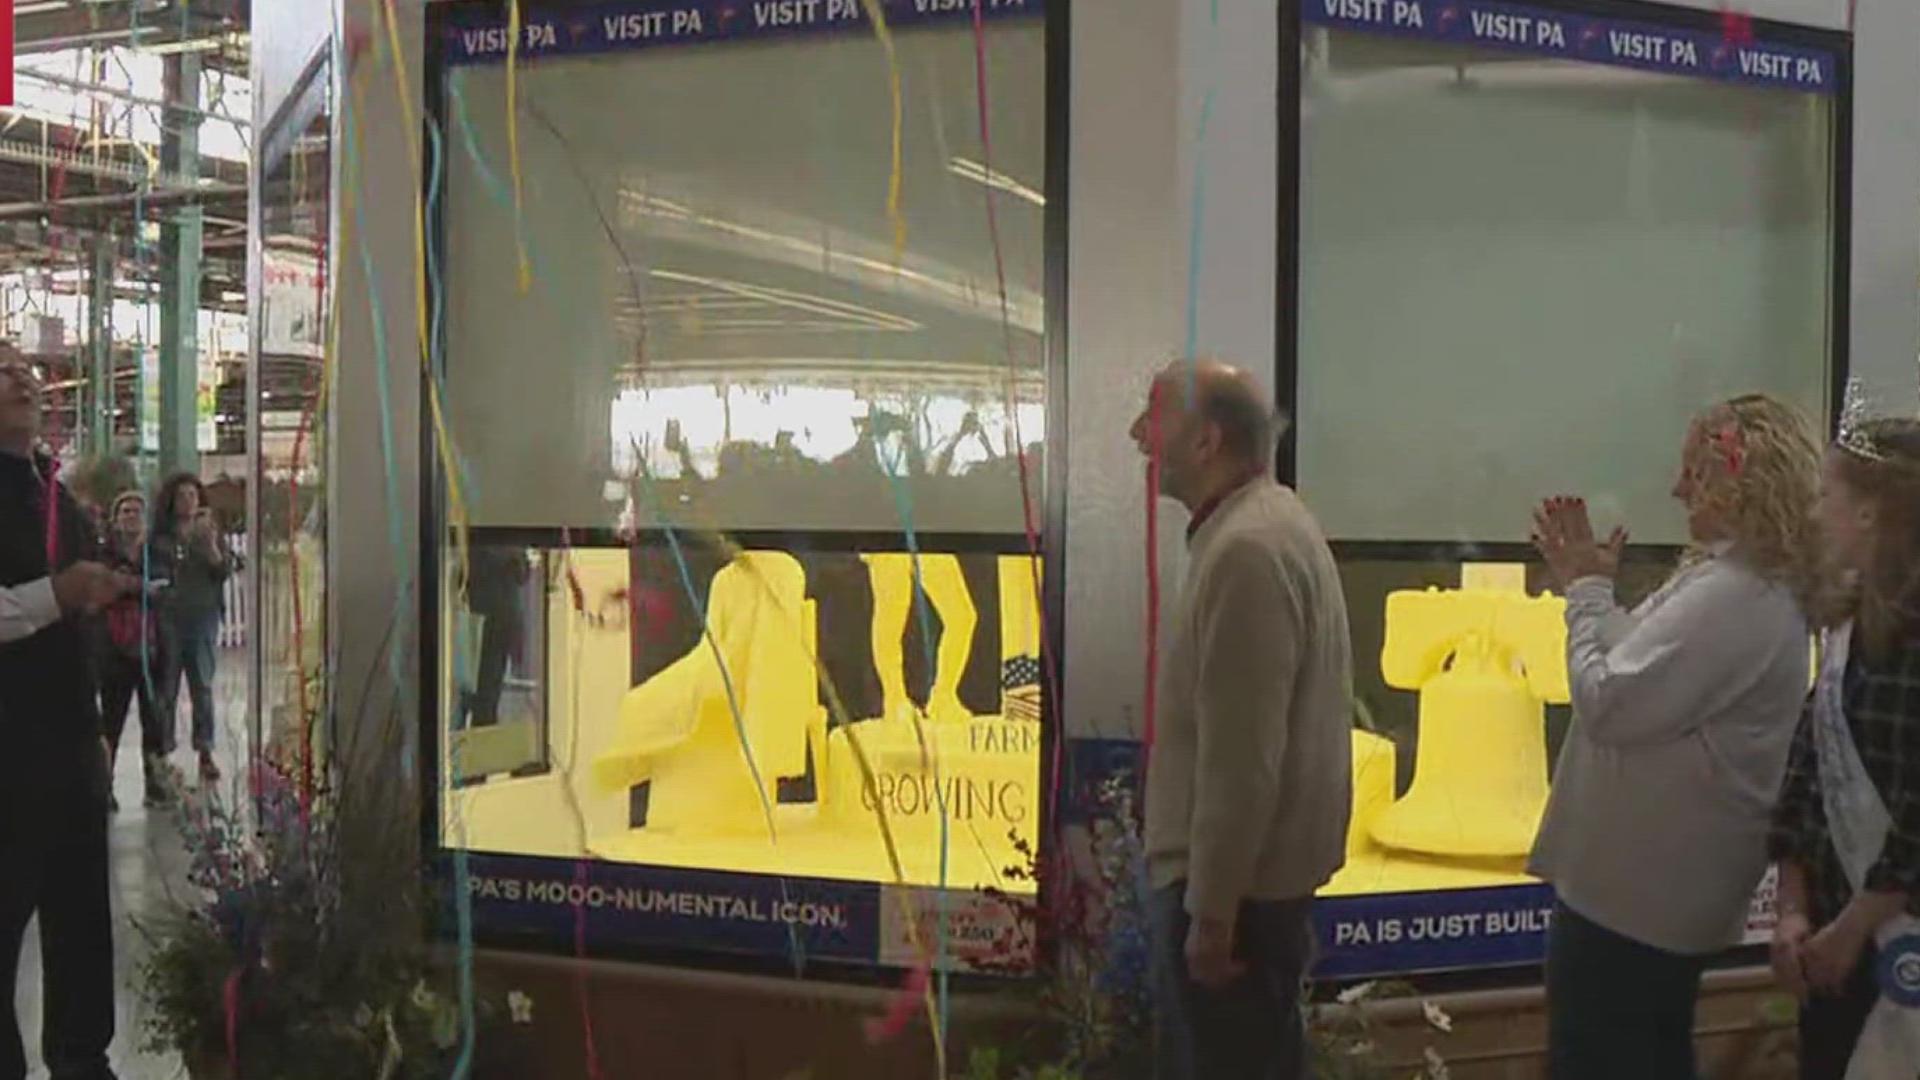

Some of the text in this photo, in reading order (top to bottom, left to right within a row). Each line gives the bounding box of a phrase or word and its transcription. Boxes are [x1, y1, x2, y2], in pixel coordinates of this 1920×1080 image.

[604, 9, 702, 41] VISIT PA
[754, 0, 859, 27] VISIT PA
[1324, 0, 1423, 28] VISIT PA
[1471, 11, 1566, 48] VISIT PA
[464, 23, 556, 55] VISI PA
[1609, 31, 1698, 66] VISIT PA
[1739, 49, 1823, 84] VISIT PA
[862, 772, 1026, 823] GROWING
[527, 880, 768, 922] MOOO-NUMENTAL
[1336, 909, 1553, 945] PA IS JUST BUILT
